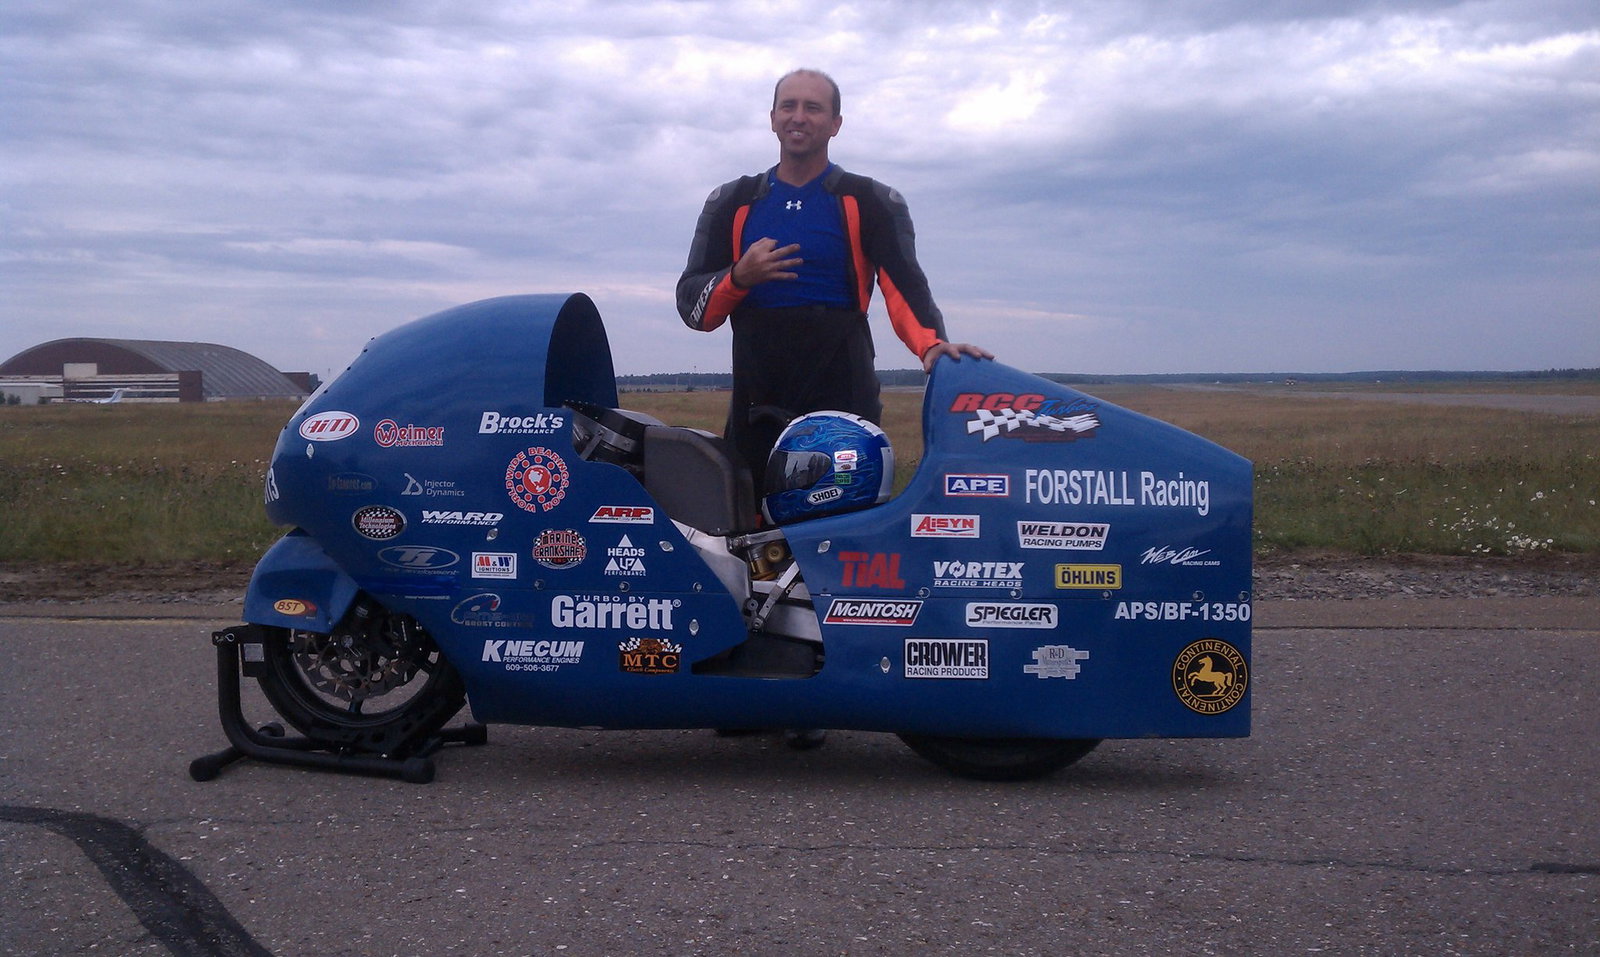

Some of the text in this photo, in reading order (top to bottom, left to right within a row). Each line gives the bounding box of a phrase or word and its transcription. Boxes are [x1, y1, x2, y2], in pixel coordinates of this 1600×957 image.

[951, 393, 1045, 412] RCC
[479, 411, 563, 434] Brock's
[374, 419, 444, 447] Weimer
[424, 479, 455, 488] Injector
[950, 479, 1003, 492] APE
[426, 488, 465, 497] Dynamics
[812, 488, 839, 502] SHOEI
[1025, 469, 1209, 516] FORSTALL Racing
[421, 511, 504, 522] WARD
[595, 507, 652, 518] ARP
[1021, 525, 1105, 538] WELDON
[1023, 538, 1102, 548] RACING PUMPS
[607, 548, 645, 556] HEADS
[934, 560, 1025, 578] VORTEX
[1061, 567, 1116, 585] ÖHLINS
[277, 602, 301, 611] BST
[832, 602, 918, 618] McINTOSH
[1114, 602, 1251, 621] APS/BF-1350
[968, 606, 1052, 624] SPIEGLER
[623, 654, 677, 668] MTC
[906, 642, 986, 666] CROWER
[1177, 642, 1242, 671] CONTINENTAL
[906, 668, 987, 676] RACING PRODUCTS
[1178, 683, 1245, 712] CONTINENTAL
